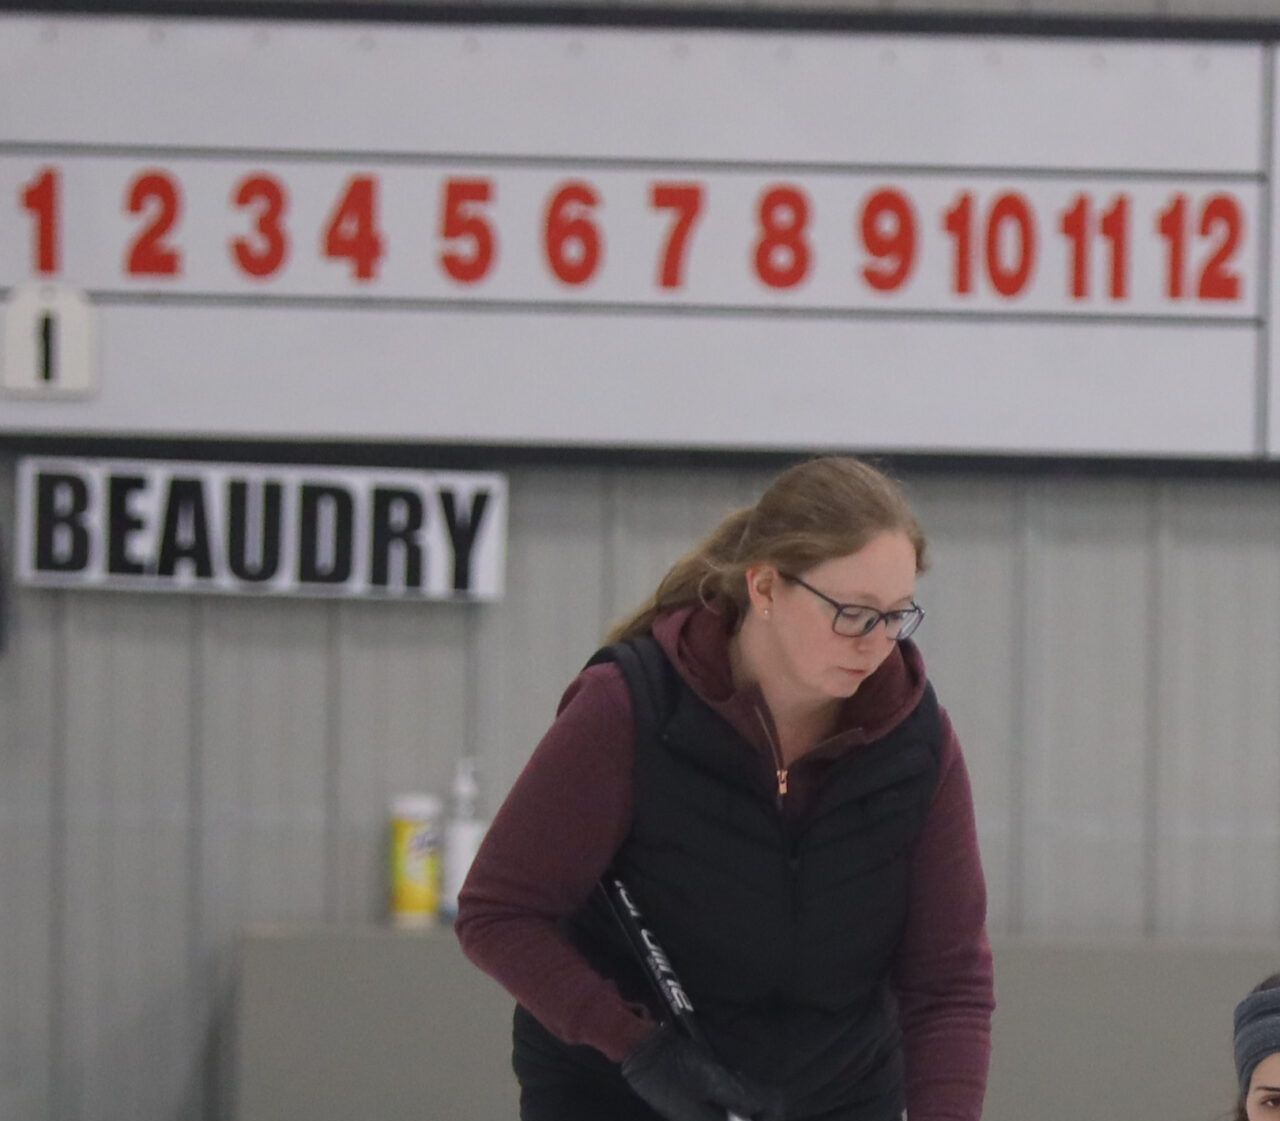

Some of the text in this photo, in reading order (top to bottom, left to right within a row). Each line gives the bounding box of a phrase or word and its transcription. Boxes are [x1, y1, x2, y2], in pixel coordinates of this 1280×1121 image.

[20, 168, 1246, 304] 1 2 3 4 5 6 7 8 9 10 11 12
[33, 472, 490, 592] BEAUDRY
